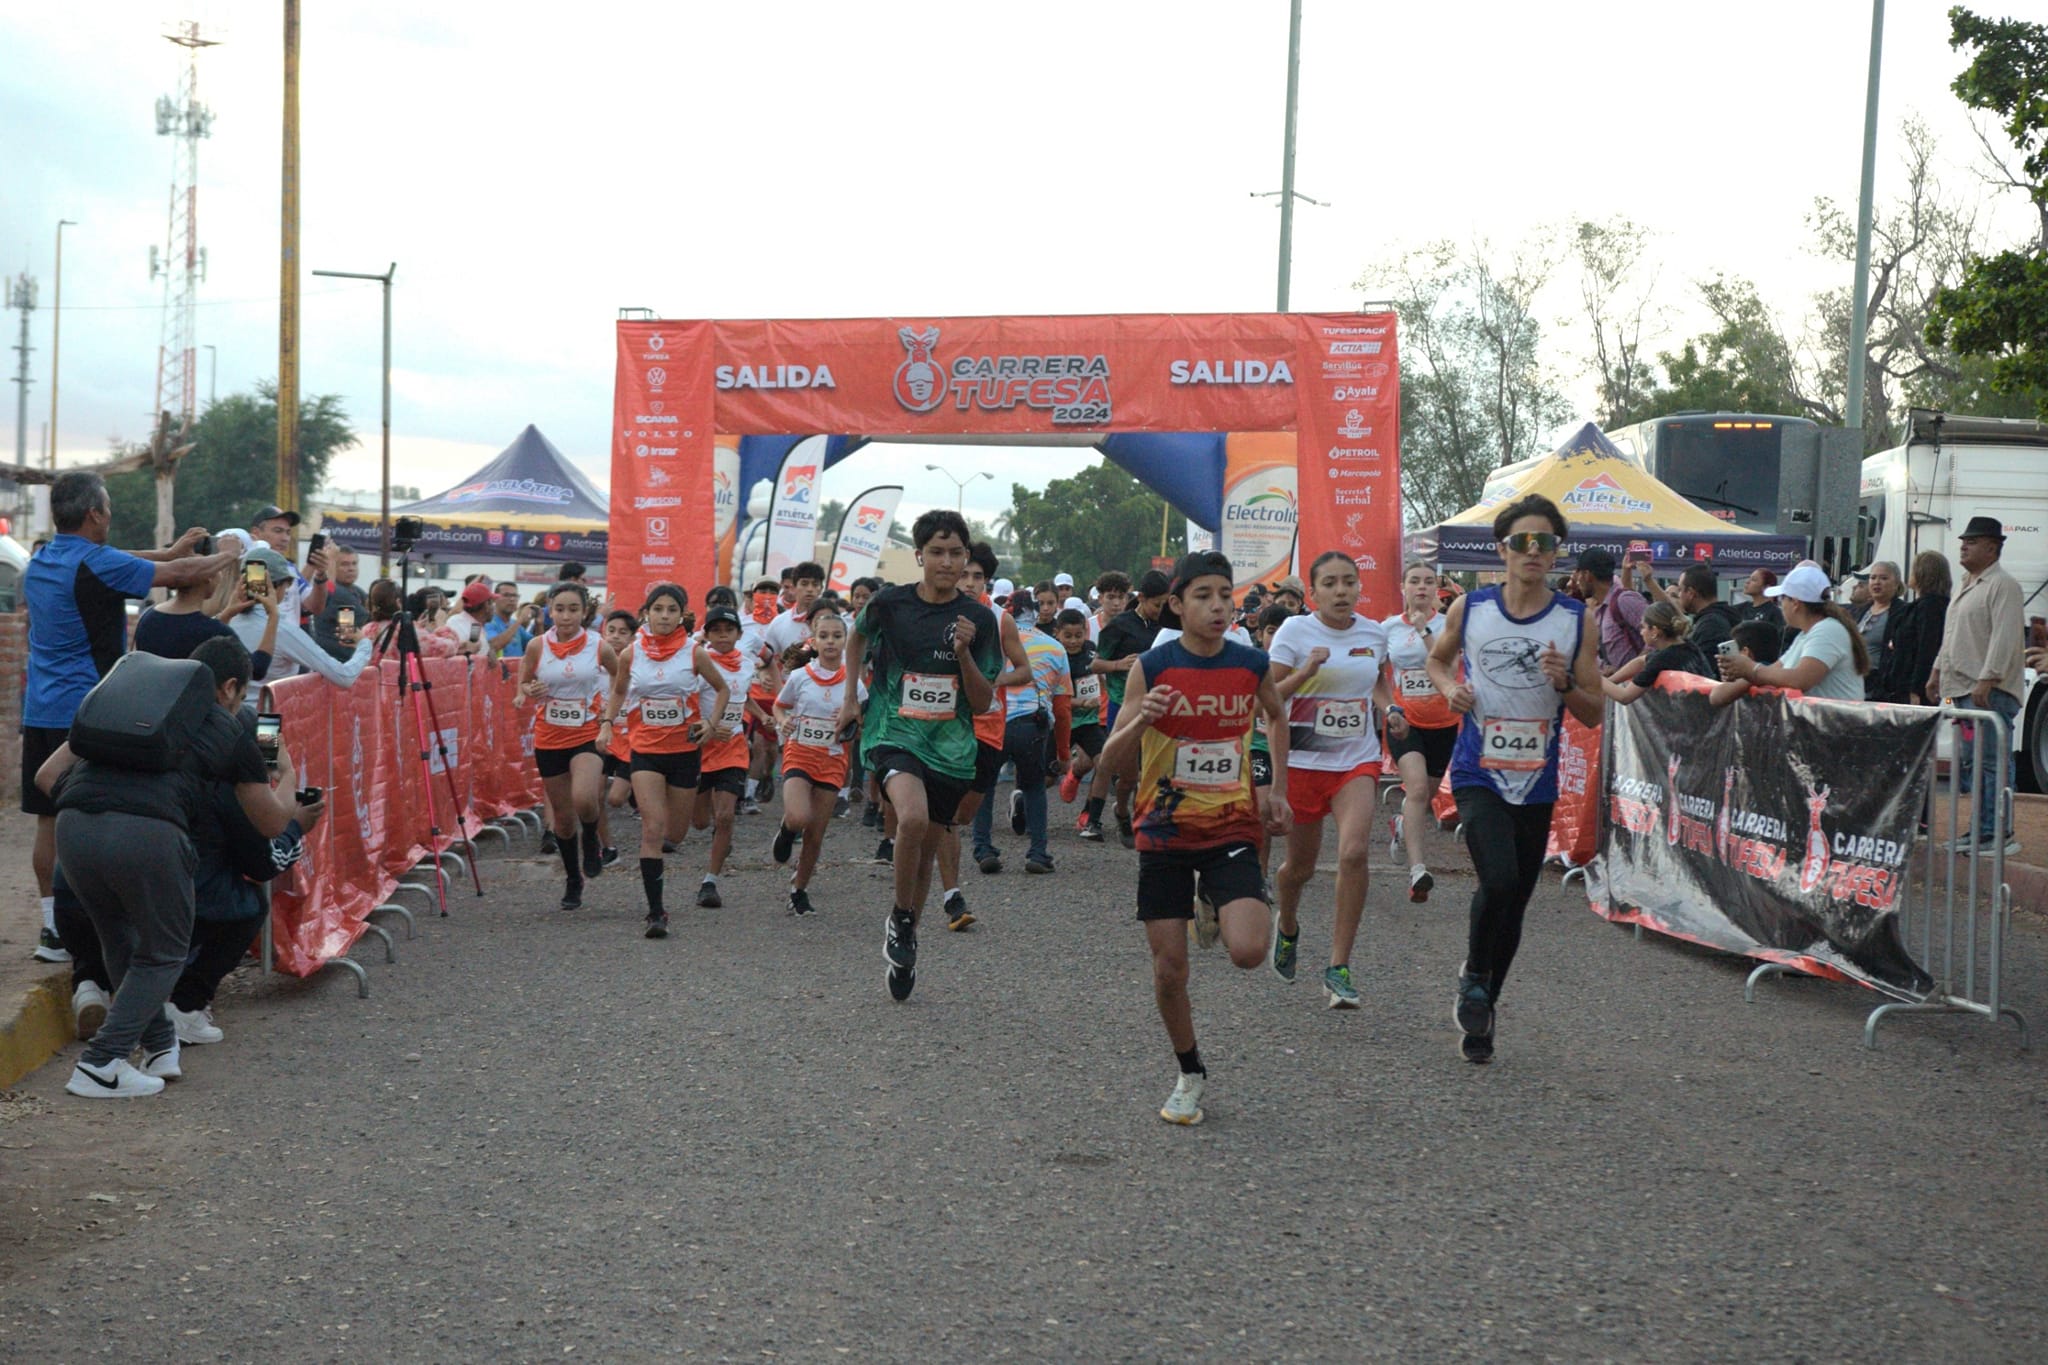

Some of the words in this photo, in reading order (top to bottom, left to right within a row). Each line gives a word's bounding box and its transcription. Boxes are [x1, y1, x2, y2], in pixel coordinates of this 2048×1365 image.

[1334, 344, 1362, 352] ACTIA
[952, 356, 1110, 376] CARRERA
[1170, 360, 1294, 384] SALIDA
[715, 365, 836, 389] SALIDA
[951, 378, 1111, 408] TUFESA
[1347, 386, 1377, 397] Ayala
[1054, 407, 1110, 421] 2024
[1340, 449, 1379, 457] PETROIL
[487, 479, 574, 498] ATLÉTICA
[1335, 496, 1371, 505] Herbal
[1226, 504, 1298, 524] Electrolit
[1718, 548, 1761, 559] Atletica
[909, 688, 951, 704] 662
[550, 708, 581, 719] 599
[646, 709, 678, 720] 659
[1322, 714, 1360, 728] 063
[803, 728, 834, 740] 597
[1491, 735, 1538, 751] 044
[1187, 758, 1232, 774] 148
[1731, 807, 1787, 842] CARRERA
[1834, 831, 1904, 867] CARRERA
